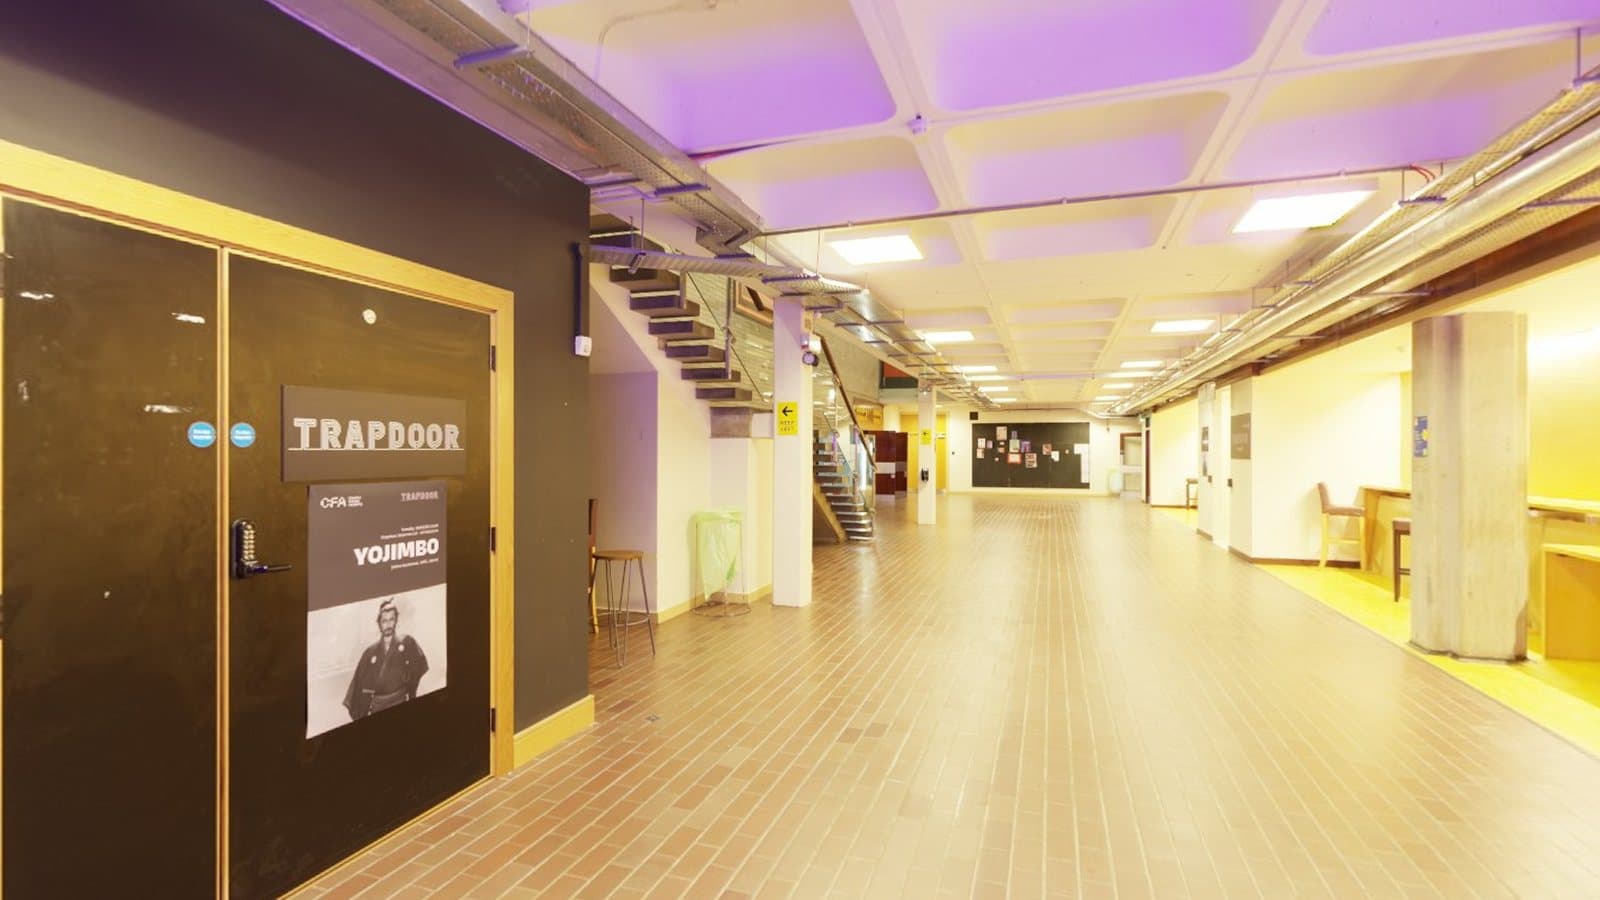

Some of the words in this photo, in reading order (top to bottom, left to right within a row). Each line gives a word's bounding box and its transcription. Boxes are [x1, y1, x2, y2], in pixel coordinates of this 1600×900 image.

[293, 417, 459, 449] TRAPDOOR
[320, 496, 347, 508] CFA
[353, 538, 439, 566] YOJIMBO
